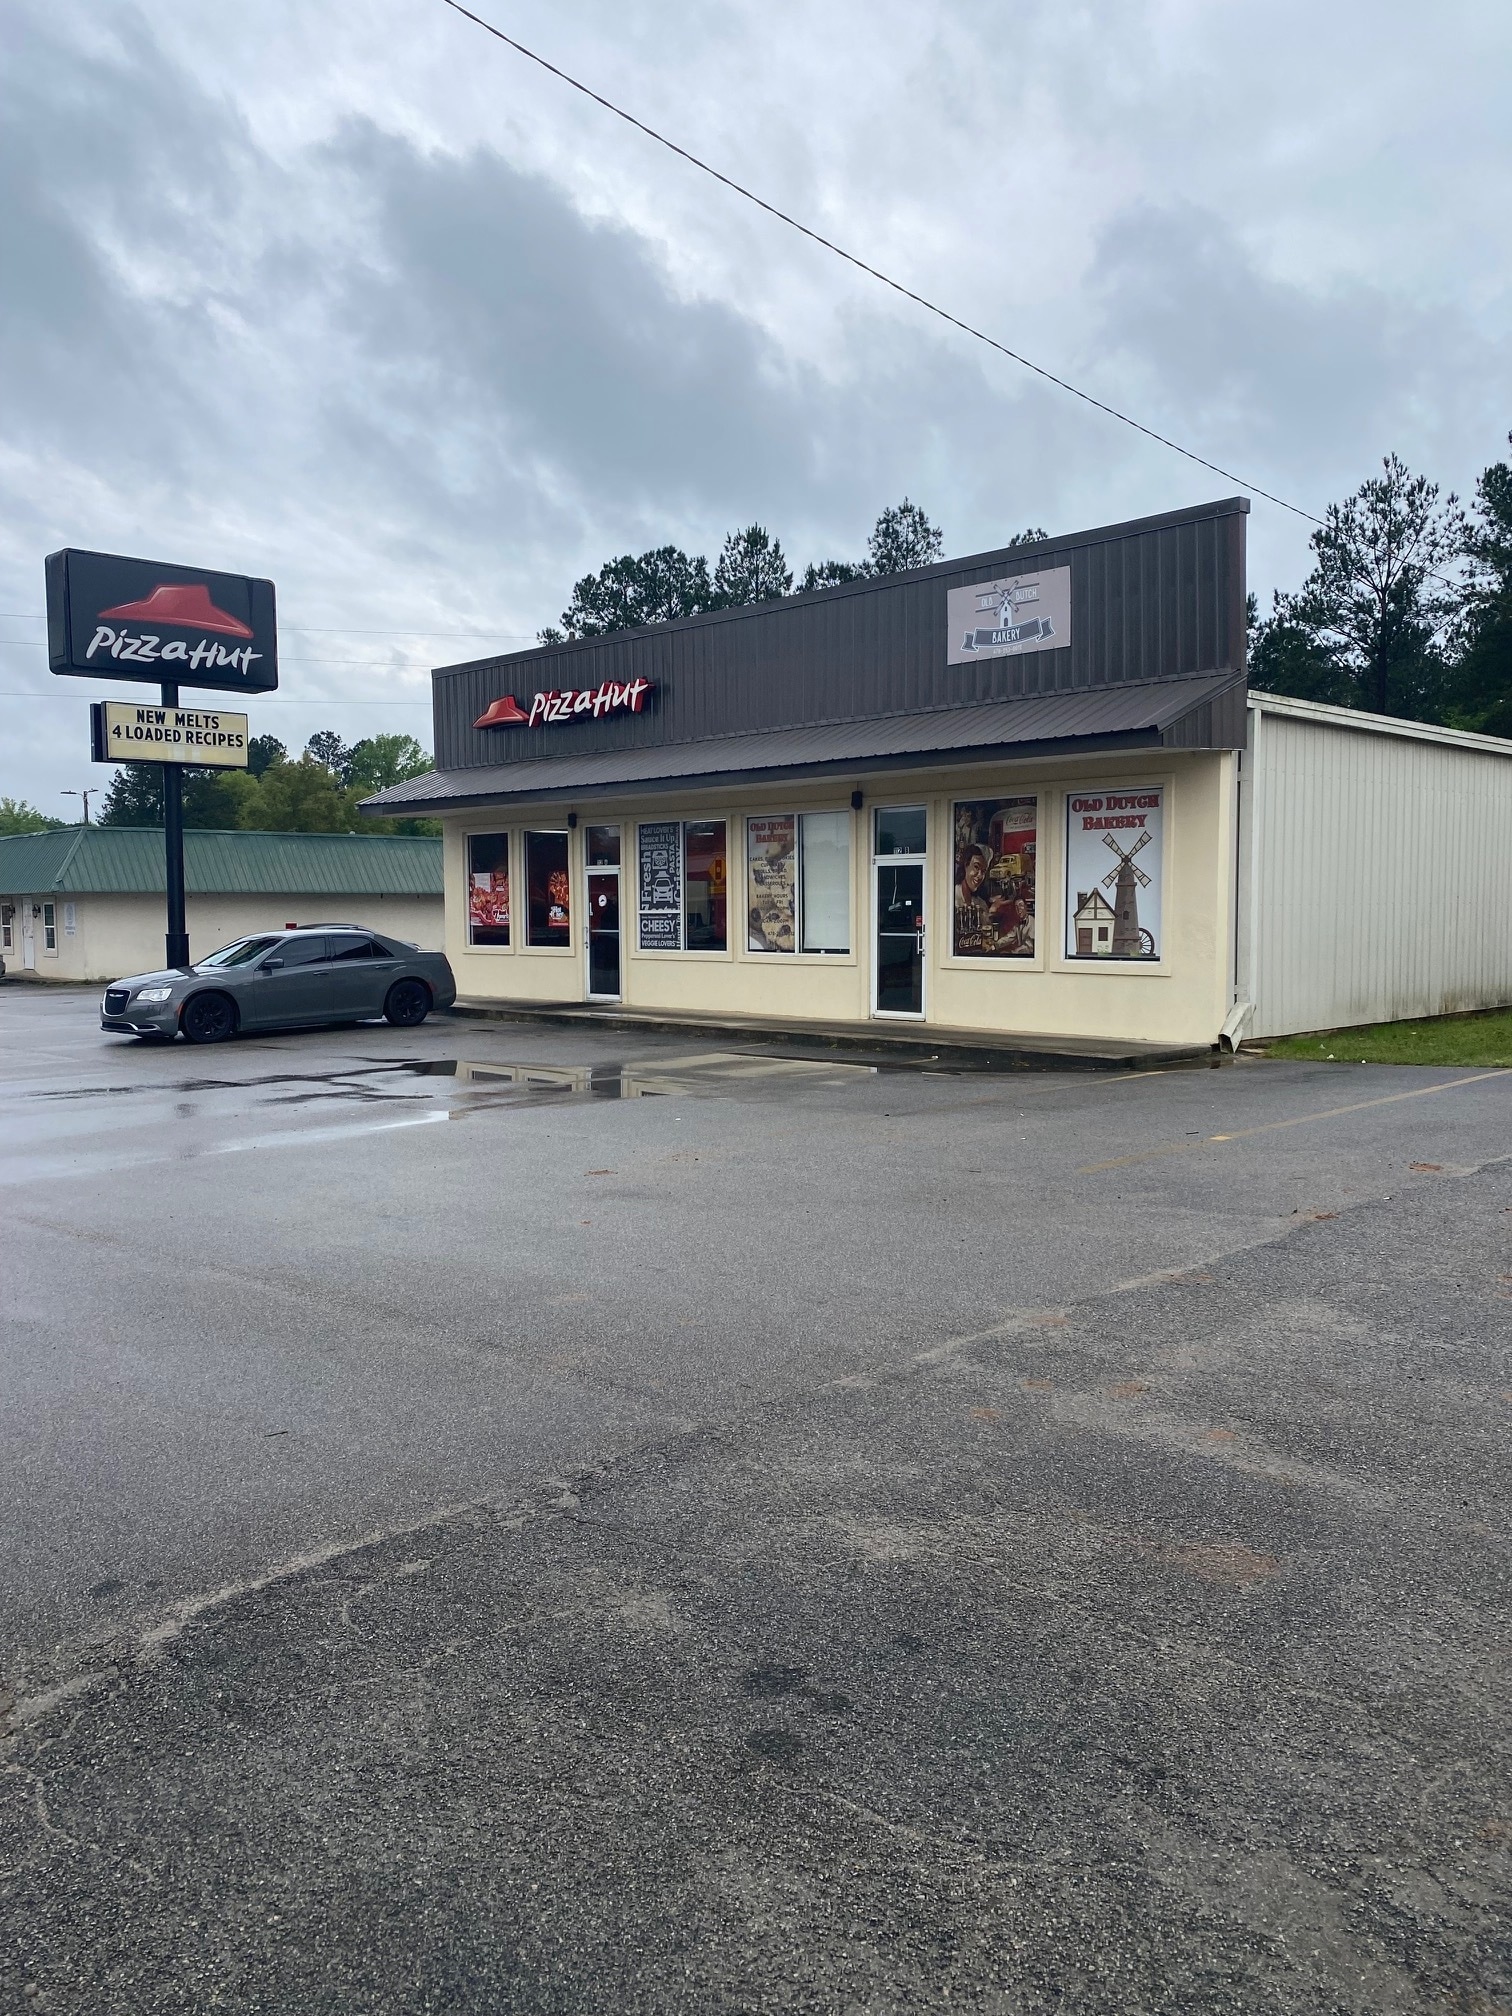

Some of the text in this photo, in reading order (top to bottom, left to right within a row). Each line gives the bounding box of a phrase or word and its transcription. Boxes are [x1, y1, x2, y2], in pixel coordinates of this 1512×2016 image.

[981, 588, 1037, 607] OLD DUTCH
[992, 627, 1020, 644] BAKERY
[86, 626, 263, 675] Pizza Hut
[529, 678, 649, 727] Pizza Hut
[137, 709, 219, 729] NEW MELTS
[112, 725, 243, 748] 4 LOADED RECIPES
[1071, 794, 1159, 813] OLD DUTCH
[1082, 814, 1148, 831] BAKERY
[641, 851, 651, 902] Fresh
[641, 919, 675, 932] CHEESY
